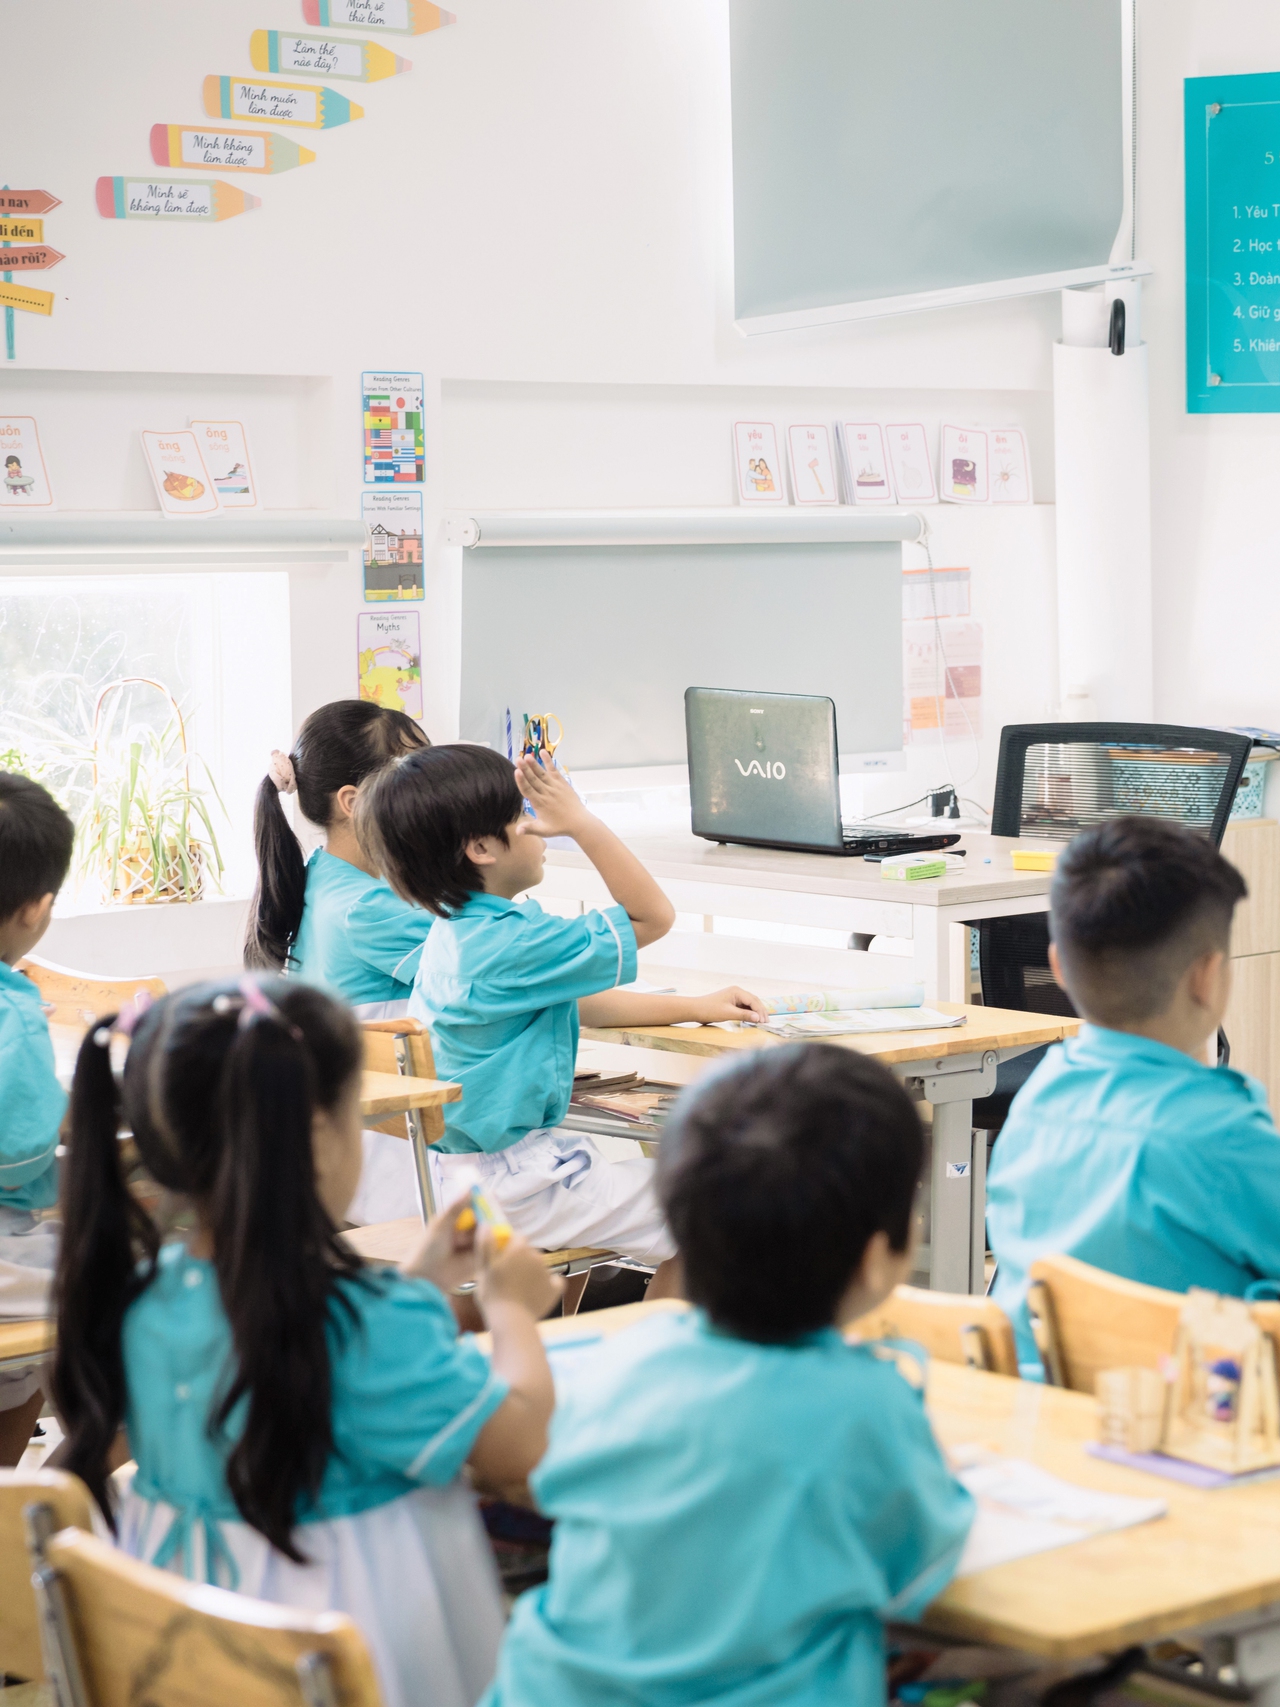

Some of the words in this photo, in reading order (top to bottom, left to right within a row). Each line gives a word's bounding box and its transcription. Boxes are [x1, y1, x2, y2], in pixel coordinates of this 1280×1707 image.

[368, 12, 386, 25] làm
[293, 40, 317, 55] Làm
[319, 42, 336, 56] thế
[293, 57, 311, 67] nào
[314, 56, 338, 72] đây?
[240, 86, 268, 101] Mình
[270, 93, 298, 104] muốn
[248, 101, 267, 115] làm
[270, 105, 294, 119] được
[193, 135, 221, 150] Mình
[223, 138, 254, 156] không
[203, 150, 222, 164] làm
[224, 153, 248, 167] được
[1264, 151, 1274, 165] 5
[147, 184, 175, 199] Mình
[177, 189, 189, 199] sẽ
[130, 198, 161, 216] không
[164, 200, 183, 212] làm
[185, 201, 209, 216] được
[1233, 206, 1241, 219] 1.
[1245, 205, 1268, 219] Yêu
[1233, 239, 1244, 253] 2.
[1249, 239, 1273, 254] Học
[21, 251, 47, 264] rồi?
[1233, 272, 1244, 286] 3.
[1249, 272, 1280, 285] Đoàn
[1233, 305, 1245, 319] 4.
[1249, 305, 1271, 319] Giữ
[1233, 339, 1245, 353] 5.
[373, 376, 392, 384] Reading
[206, 427, 228, 441] ông
[747, 429, 763, 442] yêu
[157, 439, 181, 453] ăng
[209, 442, 230, 453] sông
[372, 495, 392, 503] Reading
[377, 623, 401, 635] Myths
[734, 758, 786, 780] VAIO
